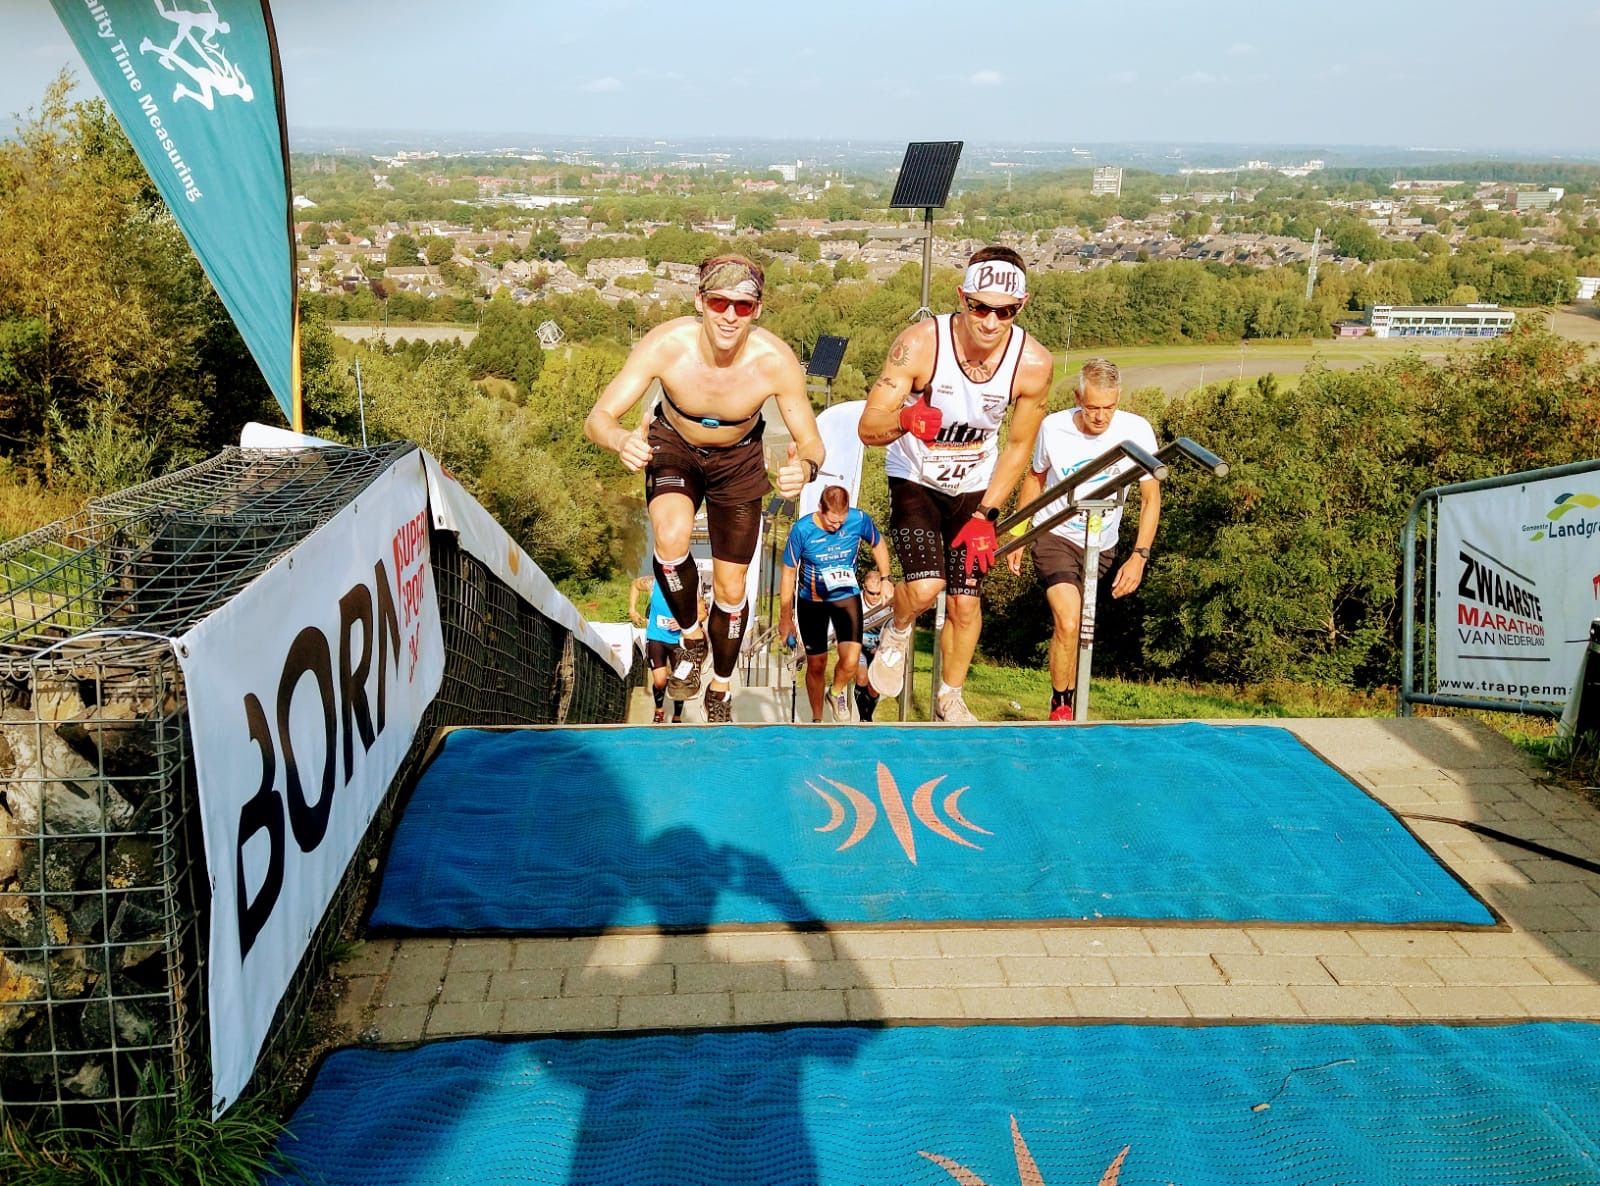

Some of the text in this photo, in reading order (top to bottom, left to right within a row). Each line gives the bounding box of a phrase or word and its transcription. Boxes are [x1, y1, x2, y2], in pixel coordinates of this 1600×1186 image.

[111, 39, 142, 92] Time
[138, 94, 203, 202] Measuring
[1458, 550, 1543, 622] ZWAARSTE
[1458, 603, 1544, 636] MARATHON
[1458, 628, 1544, 647] VAN NEDERLAND
[1438, 679, 1572, 697] www.trappenm
[237, 558, 402, 965] BORN
